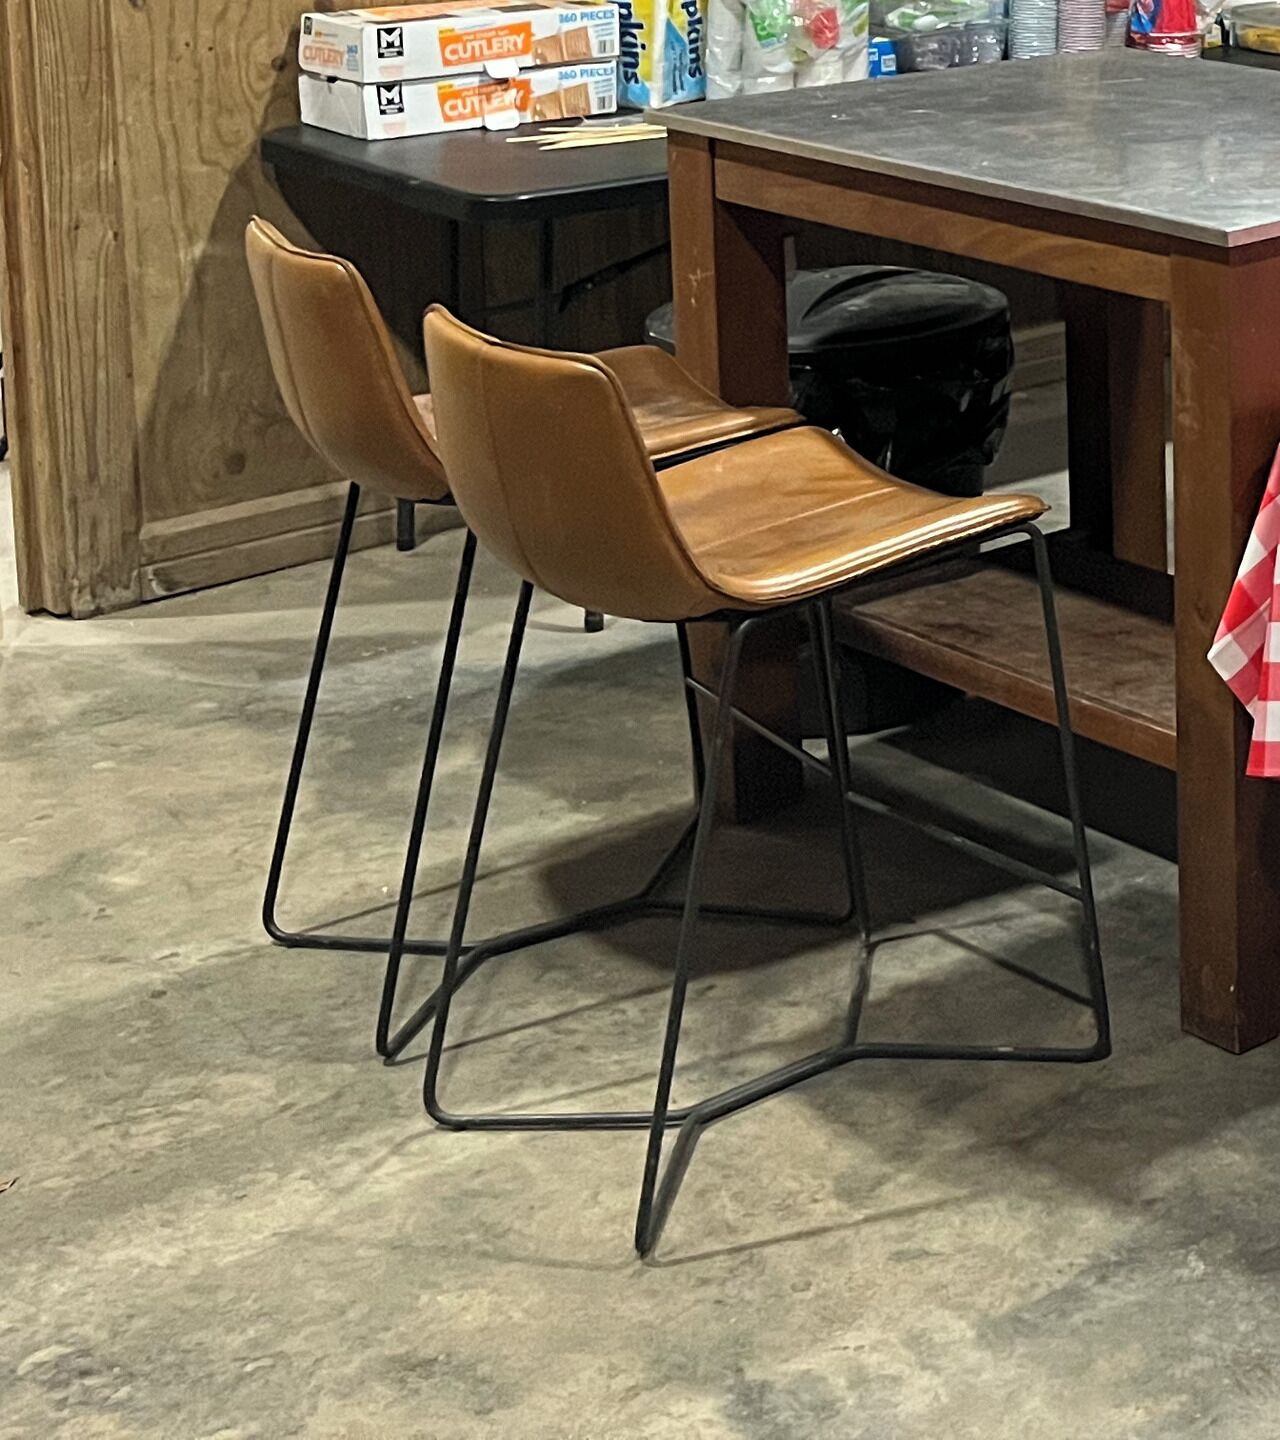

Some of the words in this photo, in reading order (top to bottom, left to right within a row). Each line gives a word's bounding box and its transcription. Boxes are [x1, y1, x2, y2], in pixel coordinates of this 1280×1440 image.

[580, 9, 616, 22] PIECES
[444, 32, 525, 61] CUTLERY
[443, 88, 525, 117] CUTLERY
